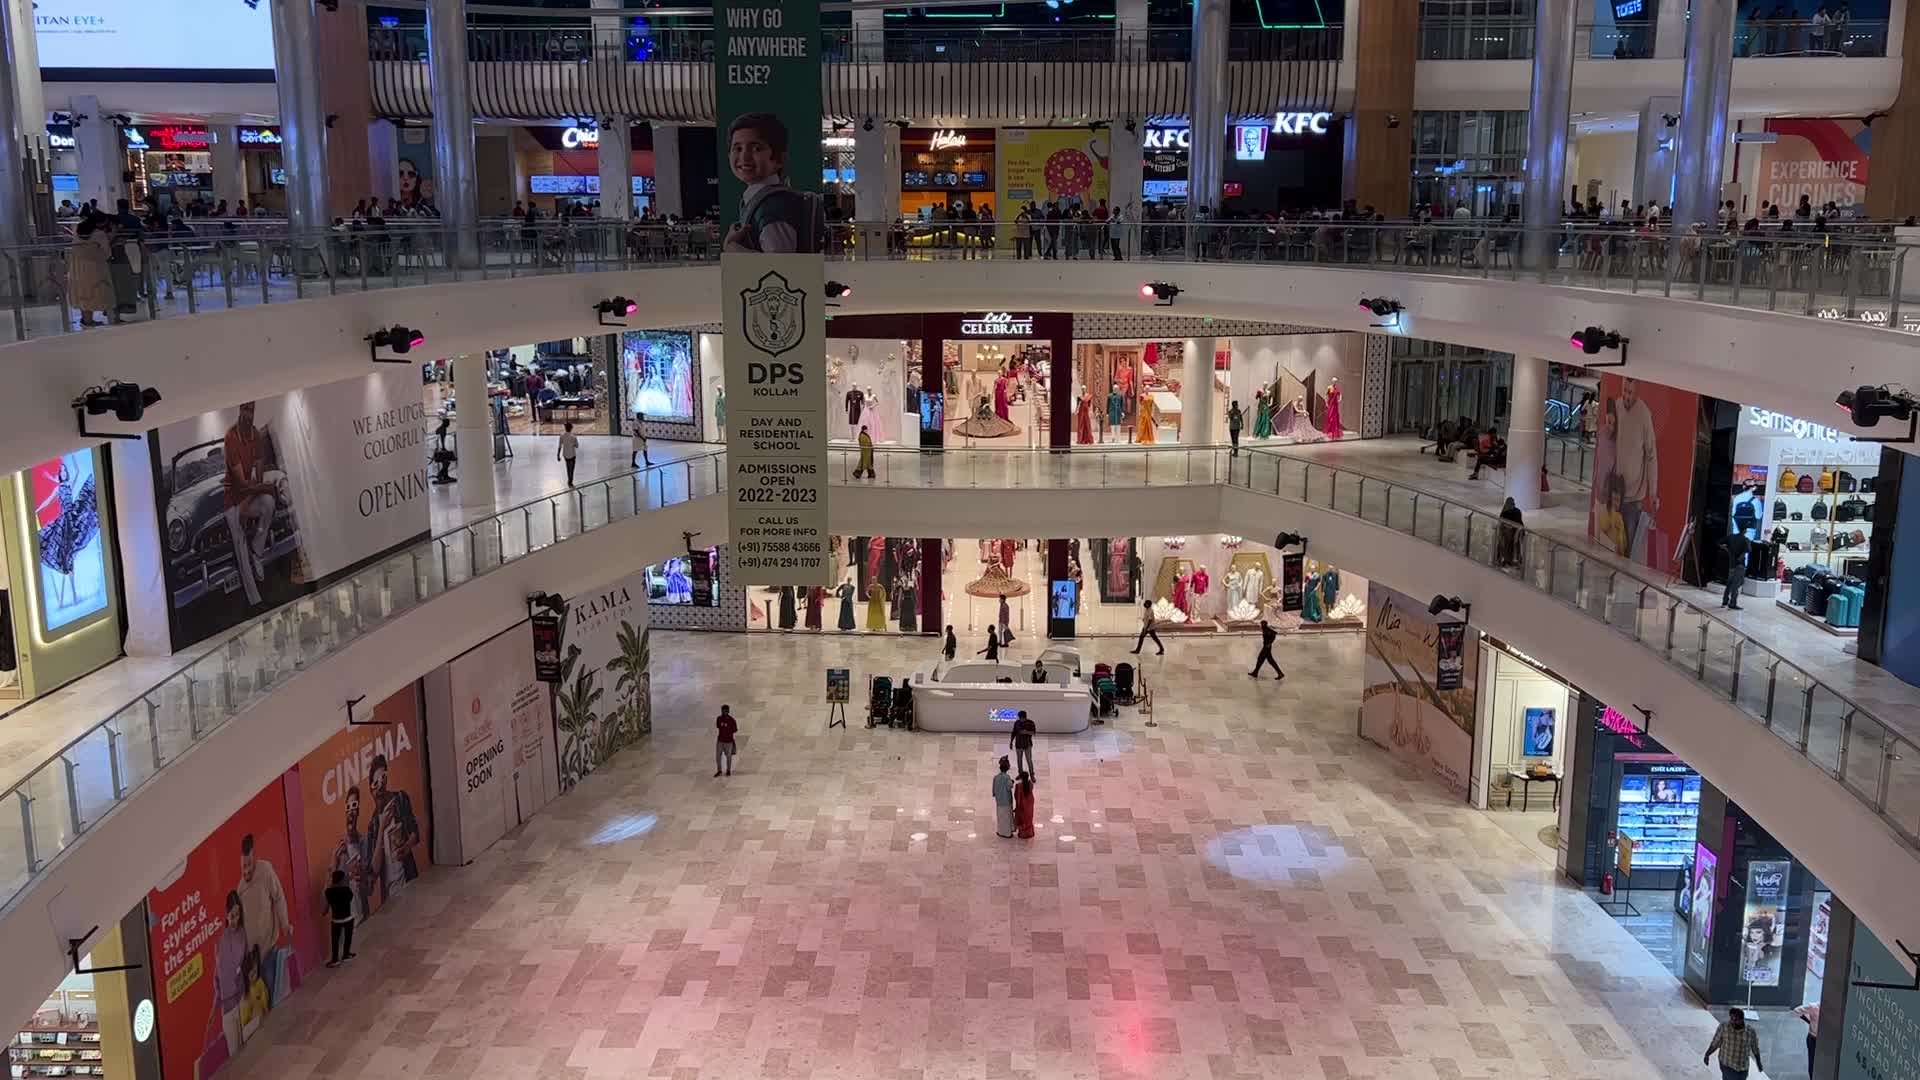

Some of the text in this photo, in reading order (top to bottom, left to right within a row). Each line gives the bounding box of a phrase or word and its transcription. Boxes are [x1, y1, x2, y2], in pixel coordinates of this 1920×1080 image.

[36, 16, 104, 25] ITAN EYE+
[726, 7, 782, 28] WHY GO
[727, 36, 807, 57] ANYWHERE
[728, 65, 770, 84] ELSE?
[1271, 112, 1331, 134] KFC
[1770, 160, 1859, 179] EXPERIENCE
[1769, 183, 1857, 208] CUISINES
[961, 323, 1033, 334] CELEBRATE
[748, 363, 804, 384] DPS
[753, 388, 798, 396] KOLLAM
[353, 416, 373, 435] WE
[376, 409, 396, 431] ARE
[751, 418, 802, 427] DAY AND
[363, 428, 420, 460] COLORFUL
[739, 430, 814, 439] RESIDENTIAL
[753, 441, 800, 450] SCHOOL
[738, 464, 817, 474] ADMISSIONS
[760, 476, 795, 486] OPEN
[738, 488, 817, 502] 2022-2023
[758, 517, 799, 525] CALL US
[740, 528, 817, 536] FOR MORE INFO
[738, 542, 760, 552] (+91)
[762, 542, 790, 551] 75588
[738, 557, 821, 568] (+91) 474 294 1707
[575, 587, 631, 625] KAMA
[1376, 596, 1401, 630] Mia
[322, 722, 412, 805] CINEMA
[466, 739, 504, 776] OPENING
[467, 765, 493, 793] SOON
[161, 890, 201, 932] For the
[163, 905, 208, 953] styles &
[164, 916, 223, 976] the smiles.
[1856, 986, 1909, 1050] INCLUDING
[1851, 1023, 1890, 1072] SPREAD
